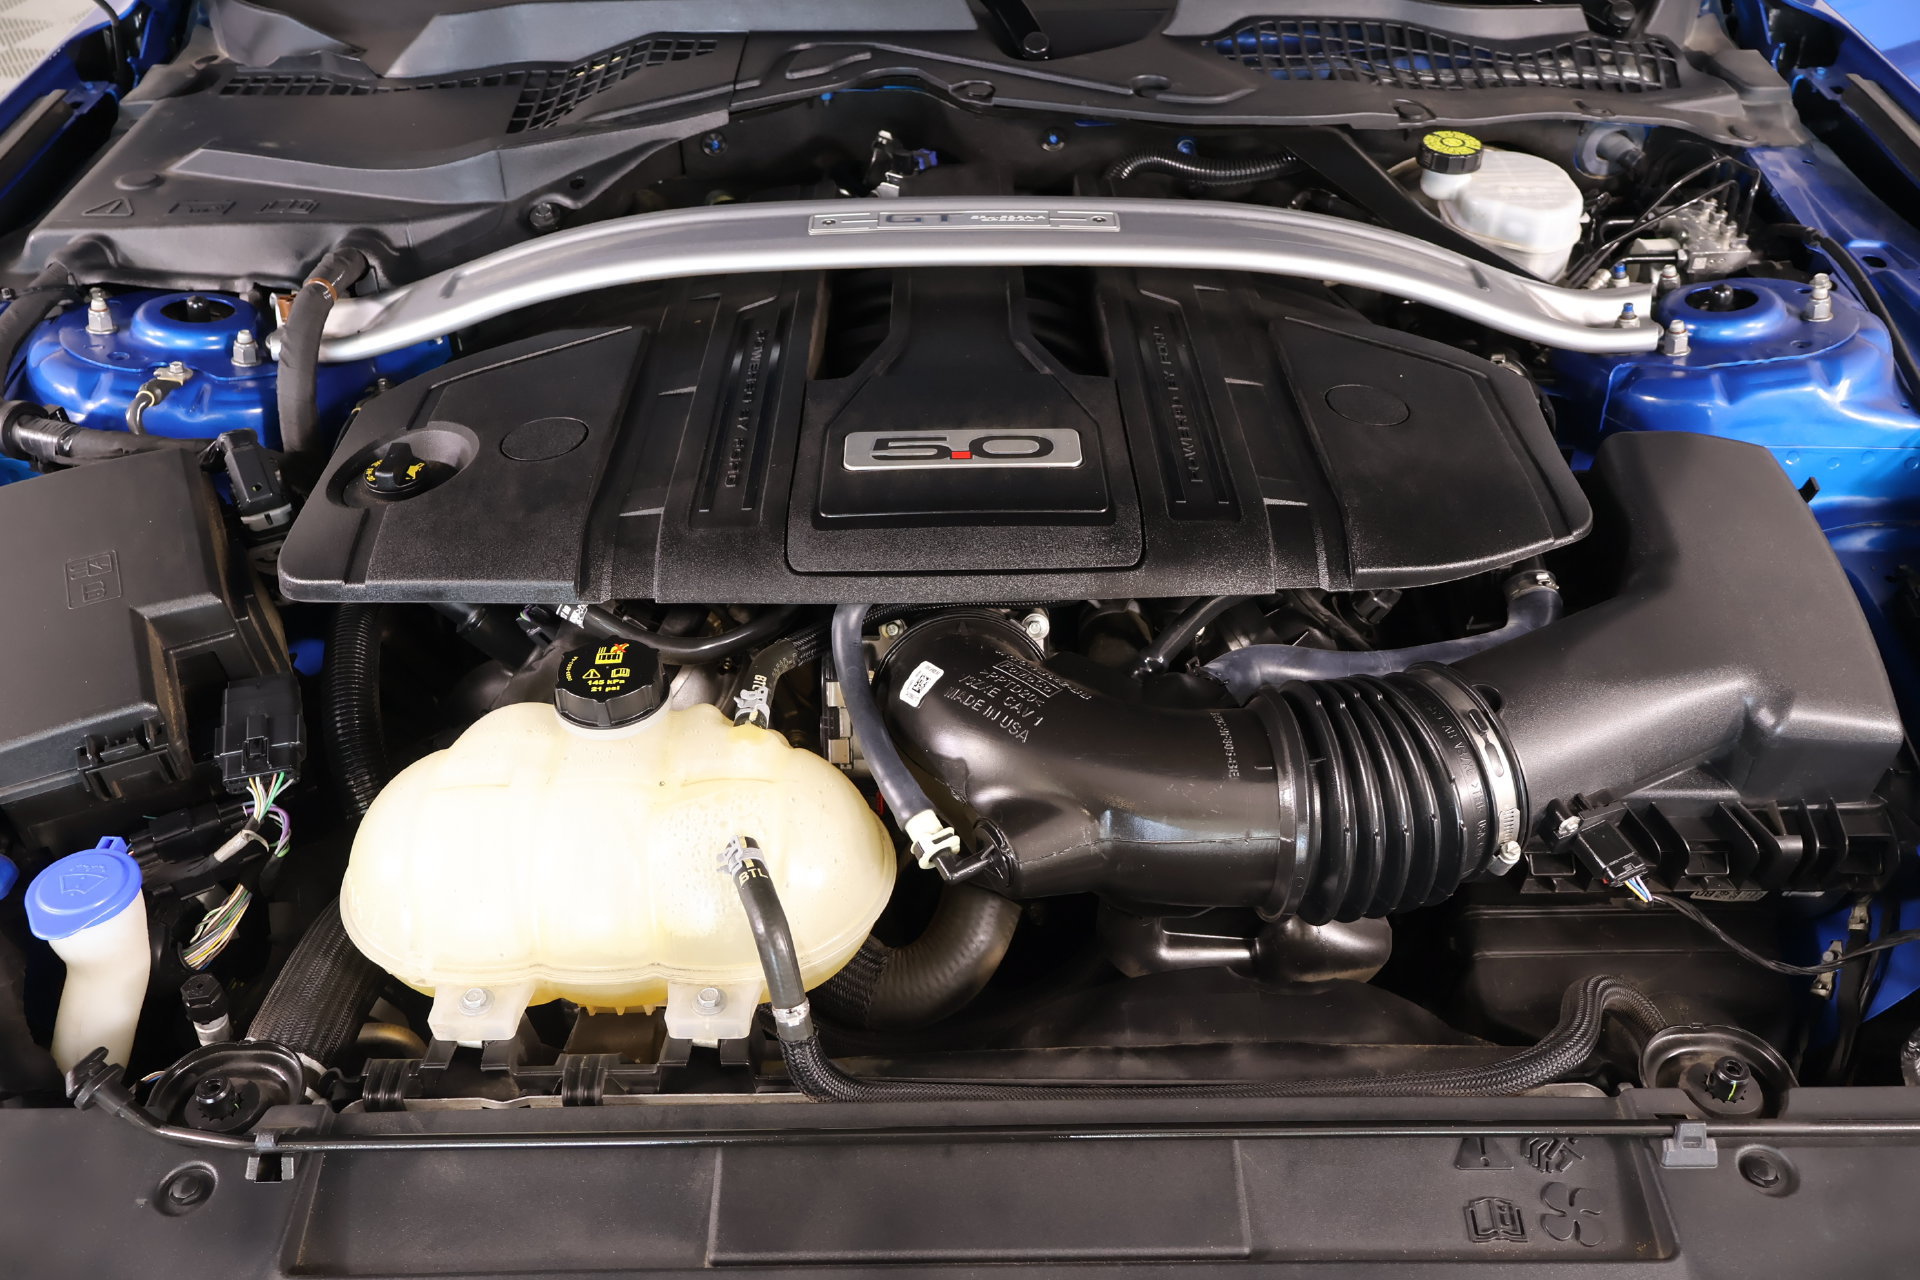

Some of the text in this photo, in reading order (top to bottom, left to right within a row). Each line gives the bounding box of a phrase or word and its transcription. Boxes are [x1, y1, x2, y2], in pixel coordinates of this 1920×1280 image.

[871, 435, 1054, 461] 5.0
[944, 686, 1030, 744] MADE IN USA
[739, 868, 769, 888] BTL
